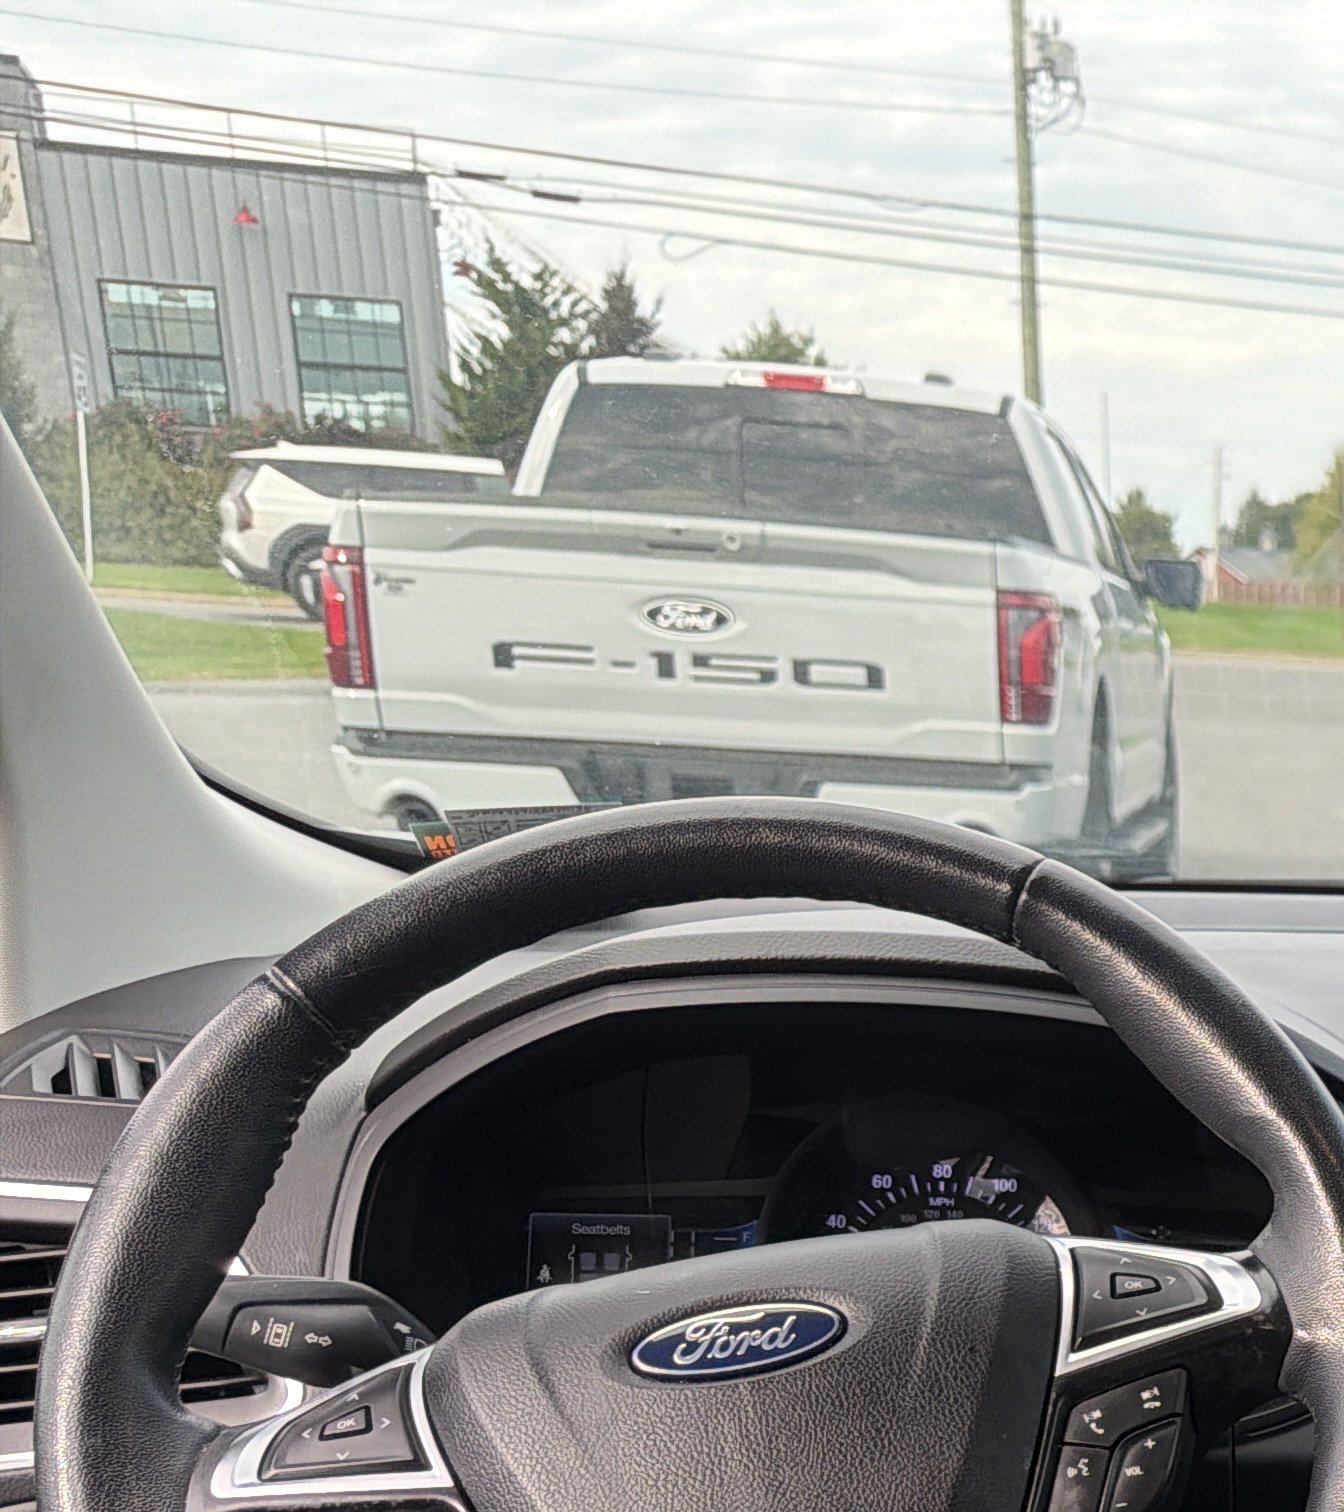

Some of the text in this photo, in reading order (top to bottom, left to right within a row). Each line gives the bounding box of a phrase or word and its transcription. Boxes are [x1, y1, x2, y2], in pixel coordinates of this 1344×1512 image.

[657, 600, 718, 631] Ford
[492, 640, 887, 691] F-150
[932, 1164, 952, 1179] 80
[871, 1175, 893, 1189] 60
[993, 1178, 1018, 1192] 100
[826, 1214, 846, 1229] 40
[570, 1222, 631, 1237] Seatbelts
[1124, 1279, 1143, 1290] OK
[673, 1308, 797, 1365] Ford
[336, 1416, 357, 1430] OK
[1124, 1465, 1144, 1476] VOL
